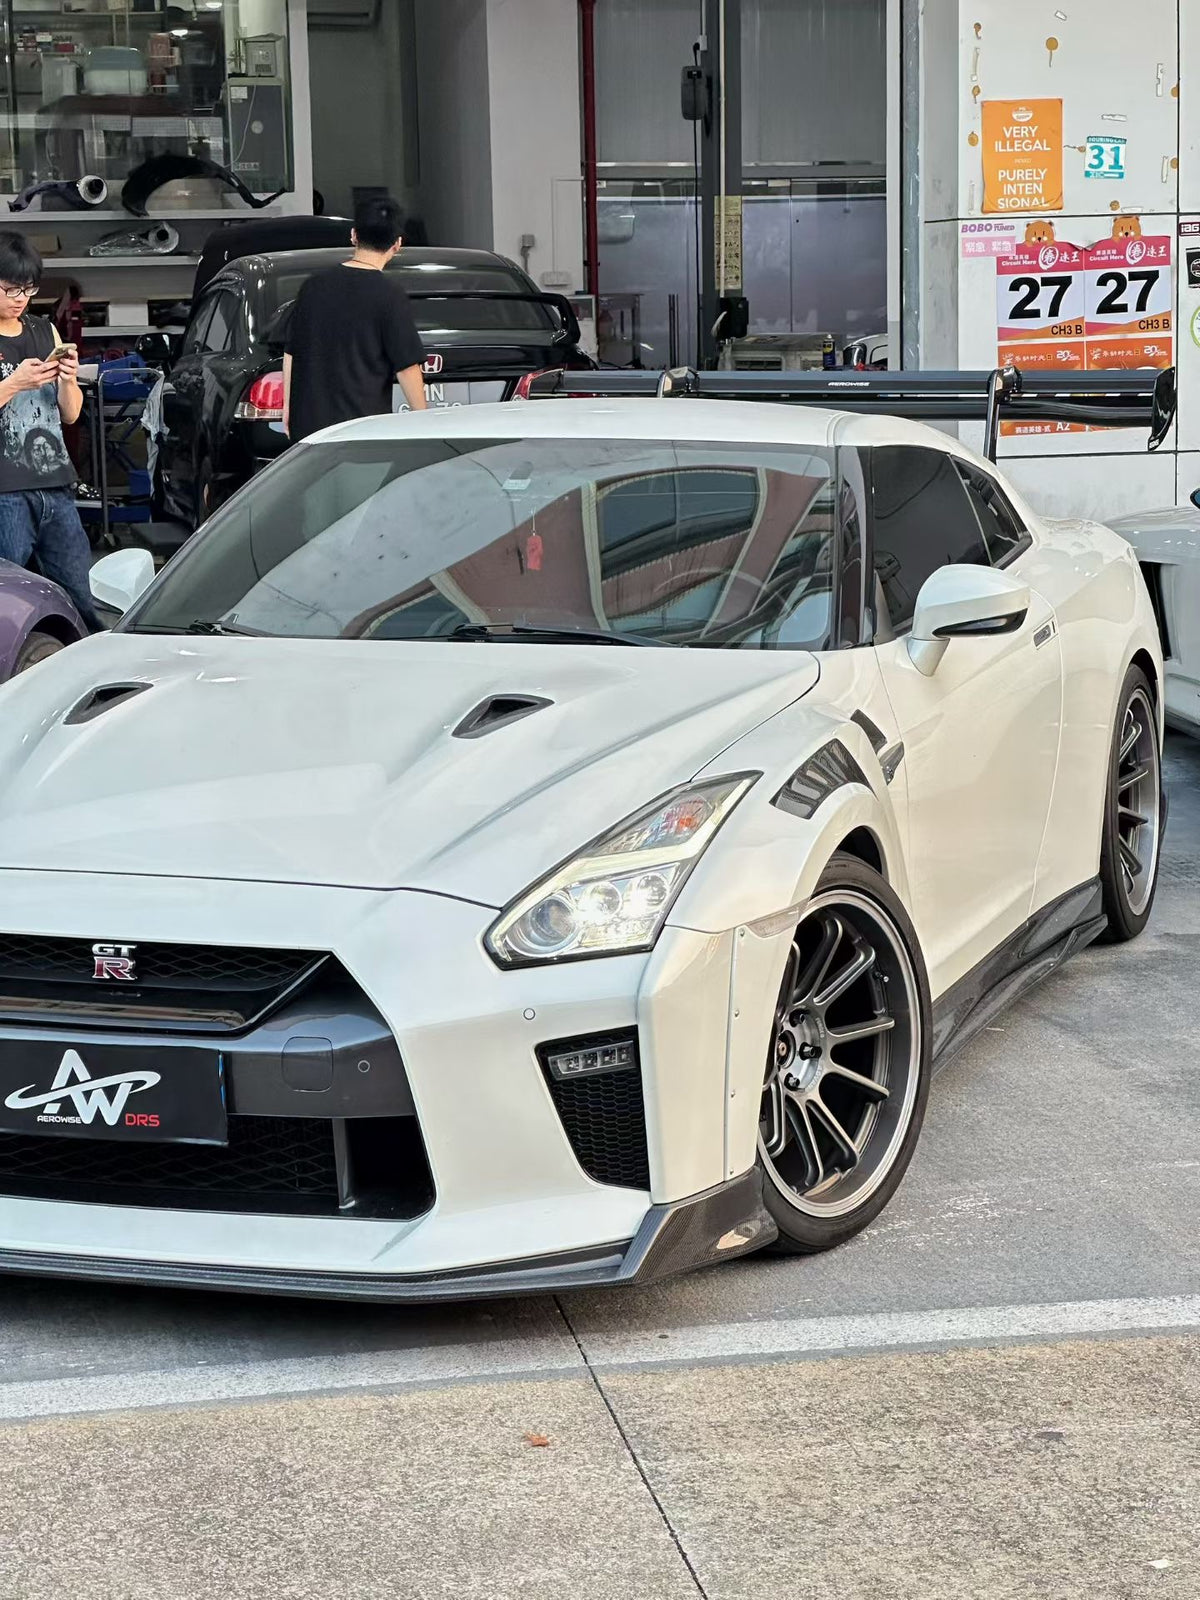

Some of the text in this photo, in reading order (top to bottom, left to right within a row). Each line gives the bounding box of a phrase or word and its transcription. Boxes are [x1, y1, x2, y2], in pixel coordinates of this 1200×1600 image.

[1003, 126, 1038, 138] VERY
[995, 139, 1051, 152] ILLEGAL
[1088, 145, 1124, 170] 31
[998, 168, 1047, 182] PURELY
[1003, 183, 1043, 195] INTEN
[997, 197, 1050, 209] SIONAL
[961, 223, 993, 233] BOBO
[1008, 275, 1073, 319] 27
[1096, 270, 1160, 315] 27
[1051, 325, 1083, 335] CH3 B
[1138, 319, 1170, 330] CH3 B
[92, 943, 137, 956] GT
[92, 957, 138, 980] R
[37, 1113, 160, 1127] AEROWISE DRS
